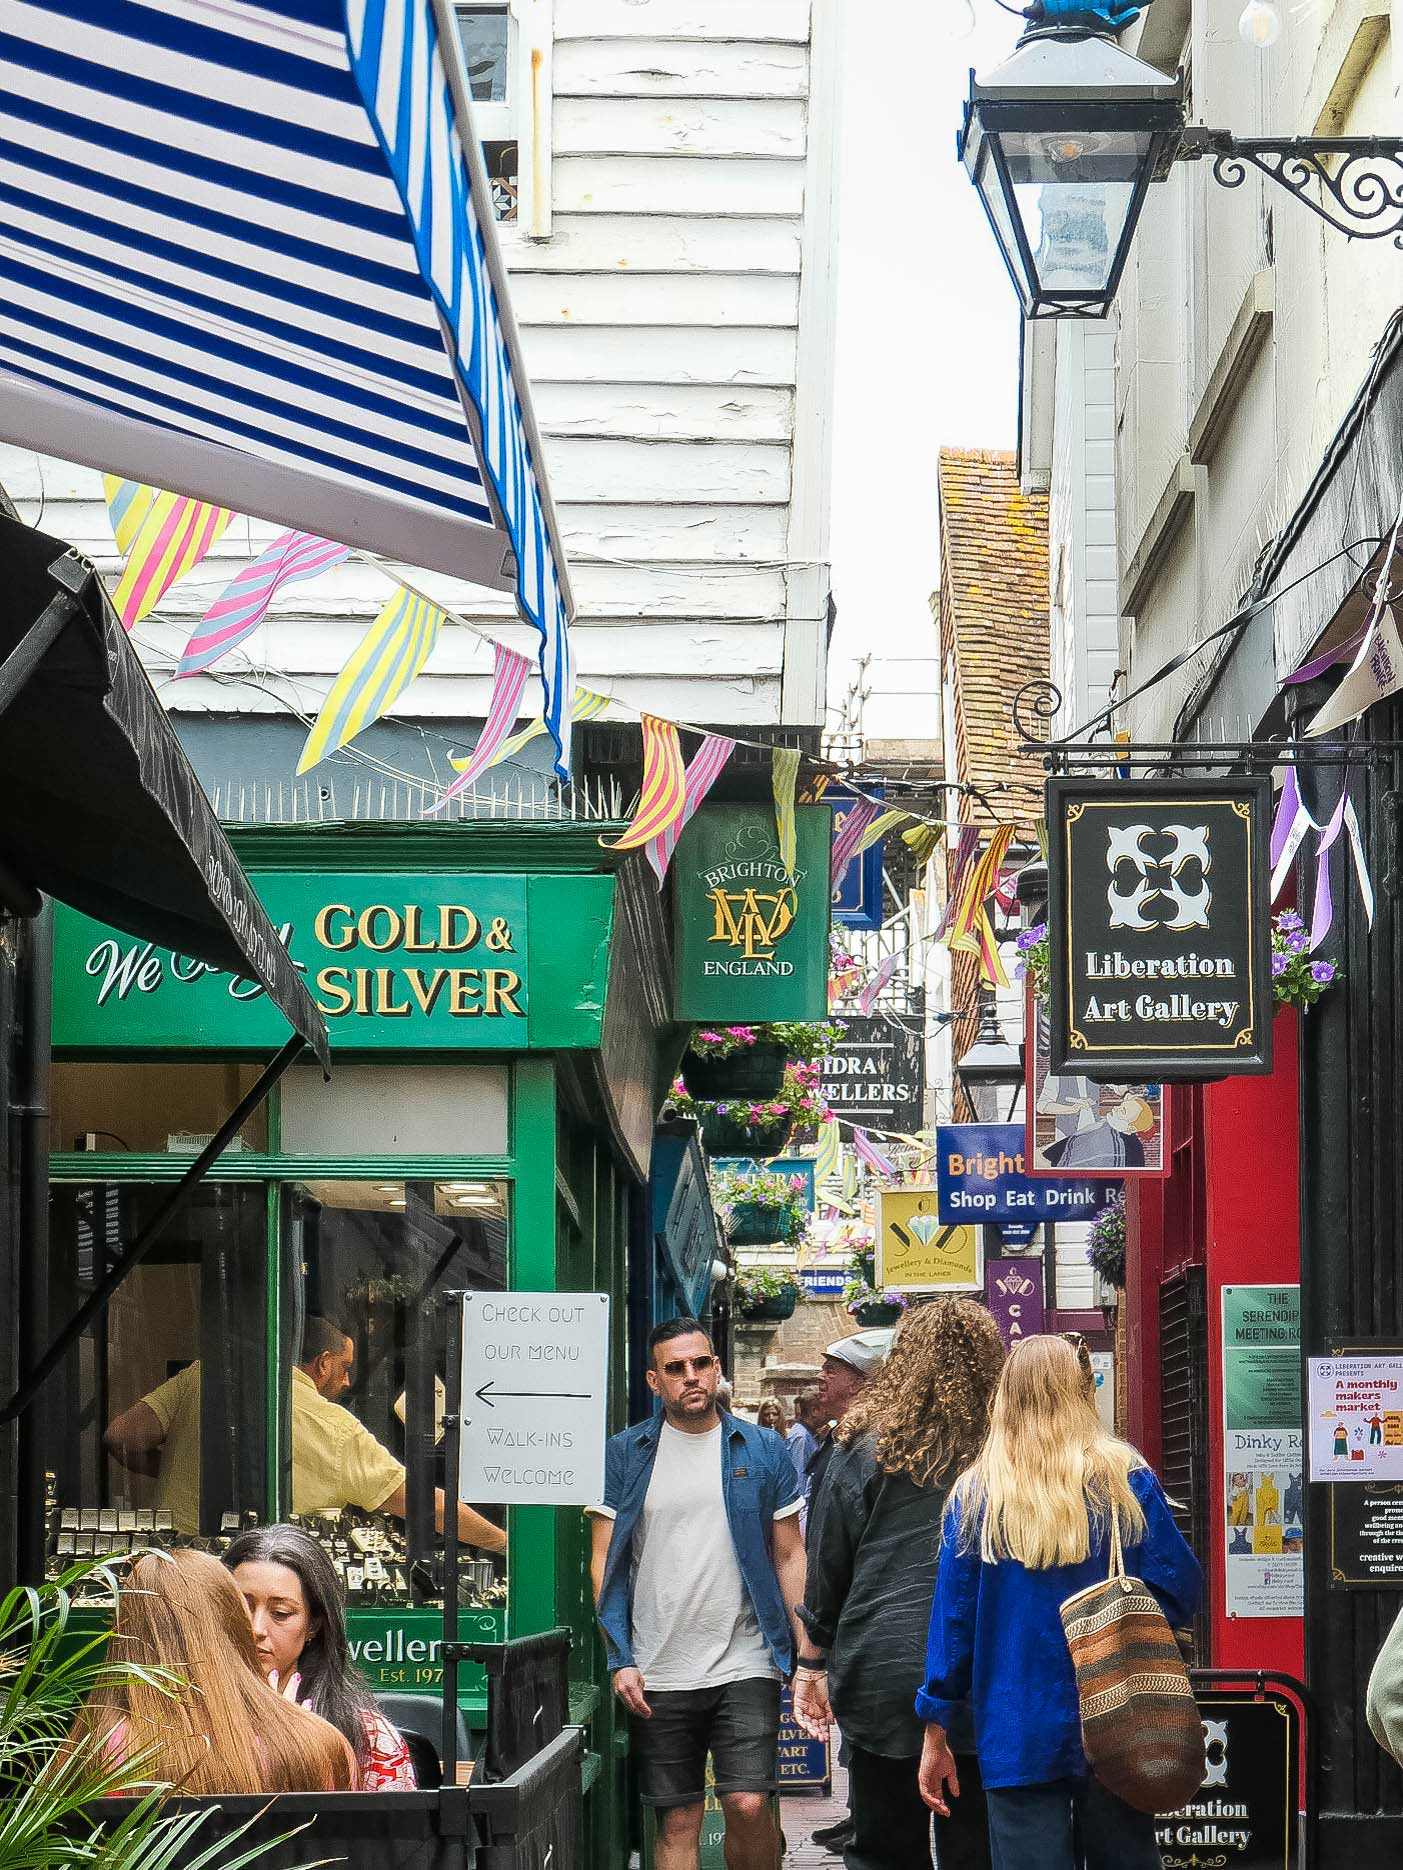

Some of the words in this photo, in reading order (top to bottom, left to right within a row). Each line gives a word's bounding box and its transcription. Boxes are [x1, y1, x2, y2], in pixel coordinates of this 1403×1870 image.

[704, 862, 801, 888] BRIGHTON
[314, 904, 480, 951] GOLD
[486, 916, 513, 951] &
[85, 939, 163, 1005] We
[703, 961, 794, 976] ENGLAND
[1085, 952, 1236, 978] Liberation
[316, 967, 523, 1015] SILVER
[1083, 996, 1132, 1022] Art
[1135, 995, 1240, 1029] Gallery
[948, 1152, 1025, 1180] Bright
[950, 1191, 997, 1210] Shop
[1006, 1190, 1035, 1206] Eat
[1046, 1188, 1096, 1205] Drink
[886, 1259, 922, 1275] Jewellery
[933, 1257, 973, 1273] Diamonds
[1267, 1292, 1289, 1305] THE
[548, 1307, 585, 1323] OUT
[1242, 1310, 1300, 1322] SERENDIP
[1235, 1327, 1286, 1340] MEETING
[484, 1344, 521, 1361] OUR
[1335, 1380, 1344, 1389] A
[1347, 1380, 1398, 1391] monthly
[1335, 1391, 1381, 1400] makers
[1335, 1402, 1381, 1411] market
[1235, 1434, 1282, 1451] Dinky
[1369, 1500, 1391, 1508] person
[1359, 1553, 1395, 1562] creative
[379, 1668, 410, 1683] Est.
[780, 1763, 810, 1775] ETC.
[1154, 1800, 1248, 1819] eration
[1155, 1828, 1174, 1846] rt
[1176, 1826, 1252, 1850] Gallery
